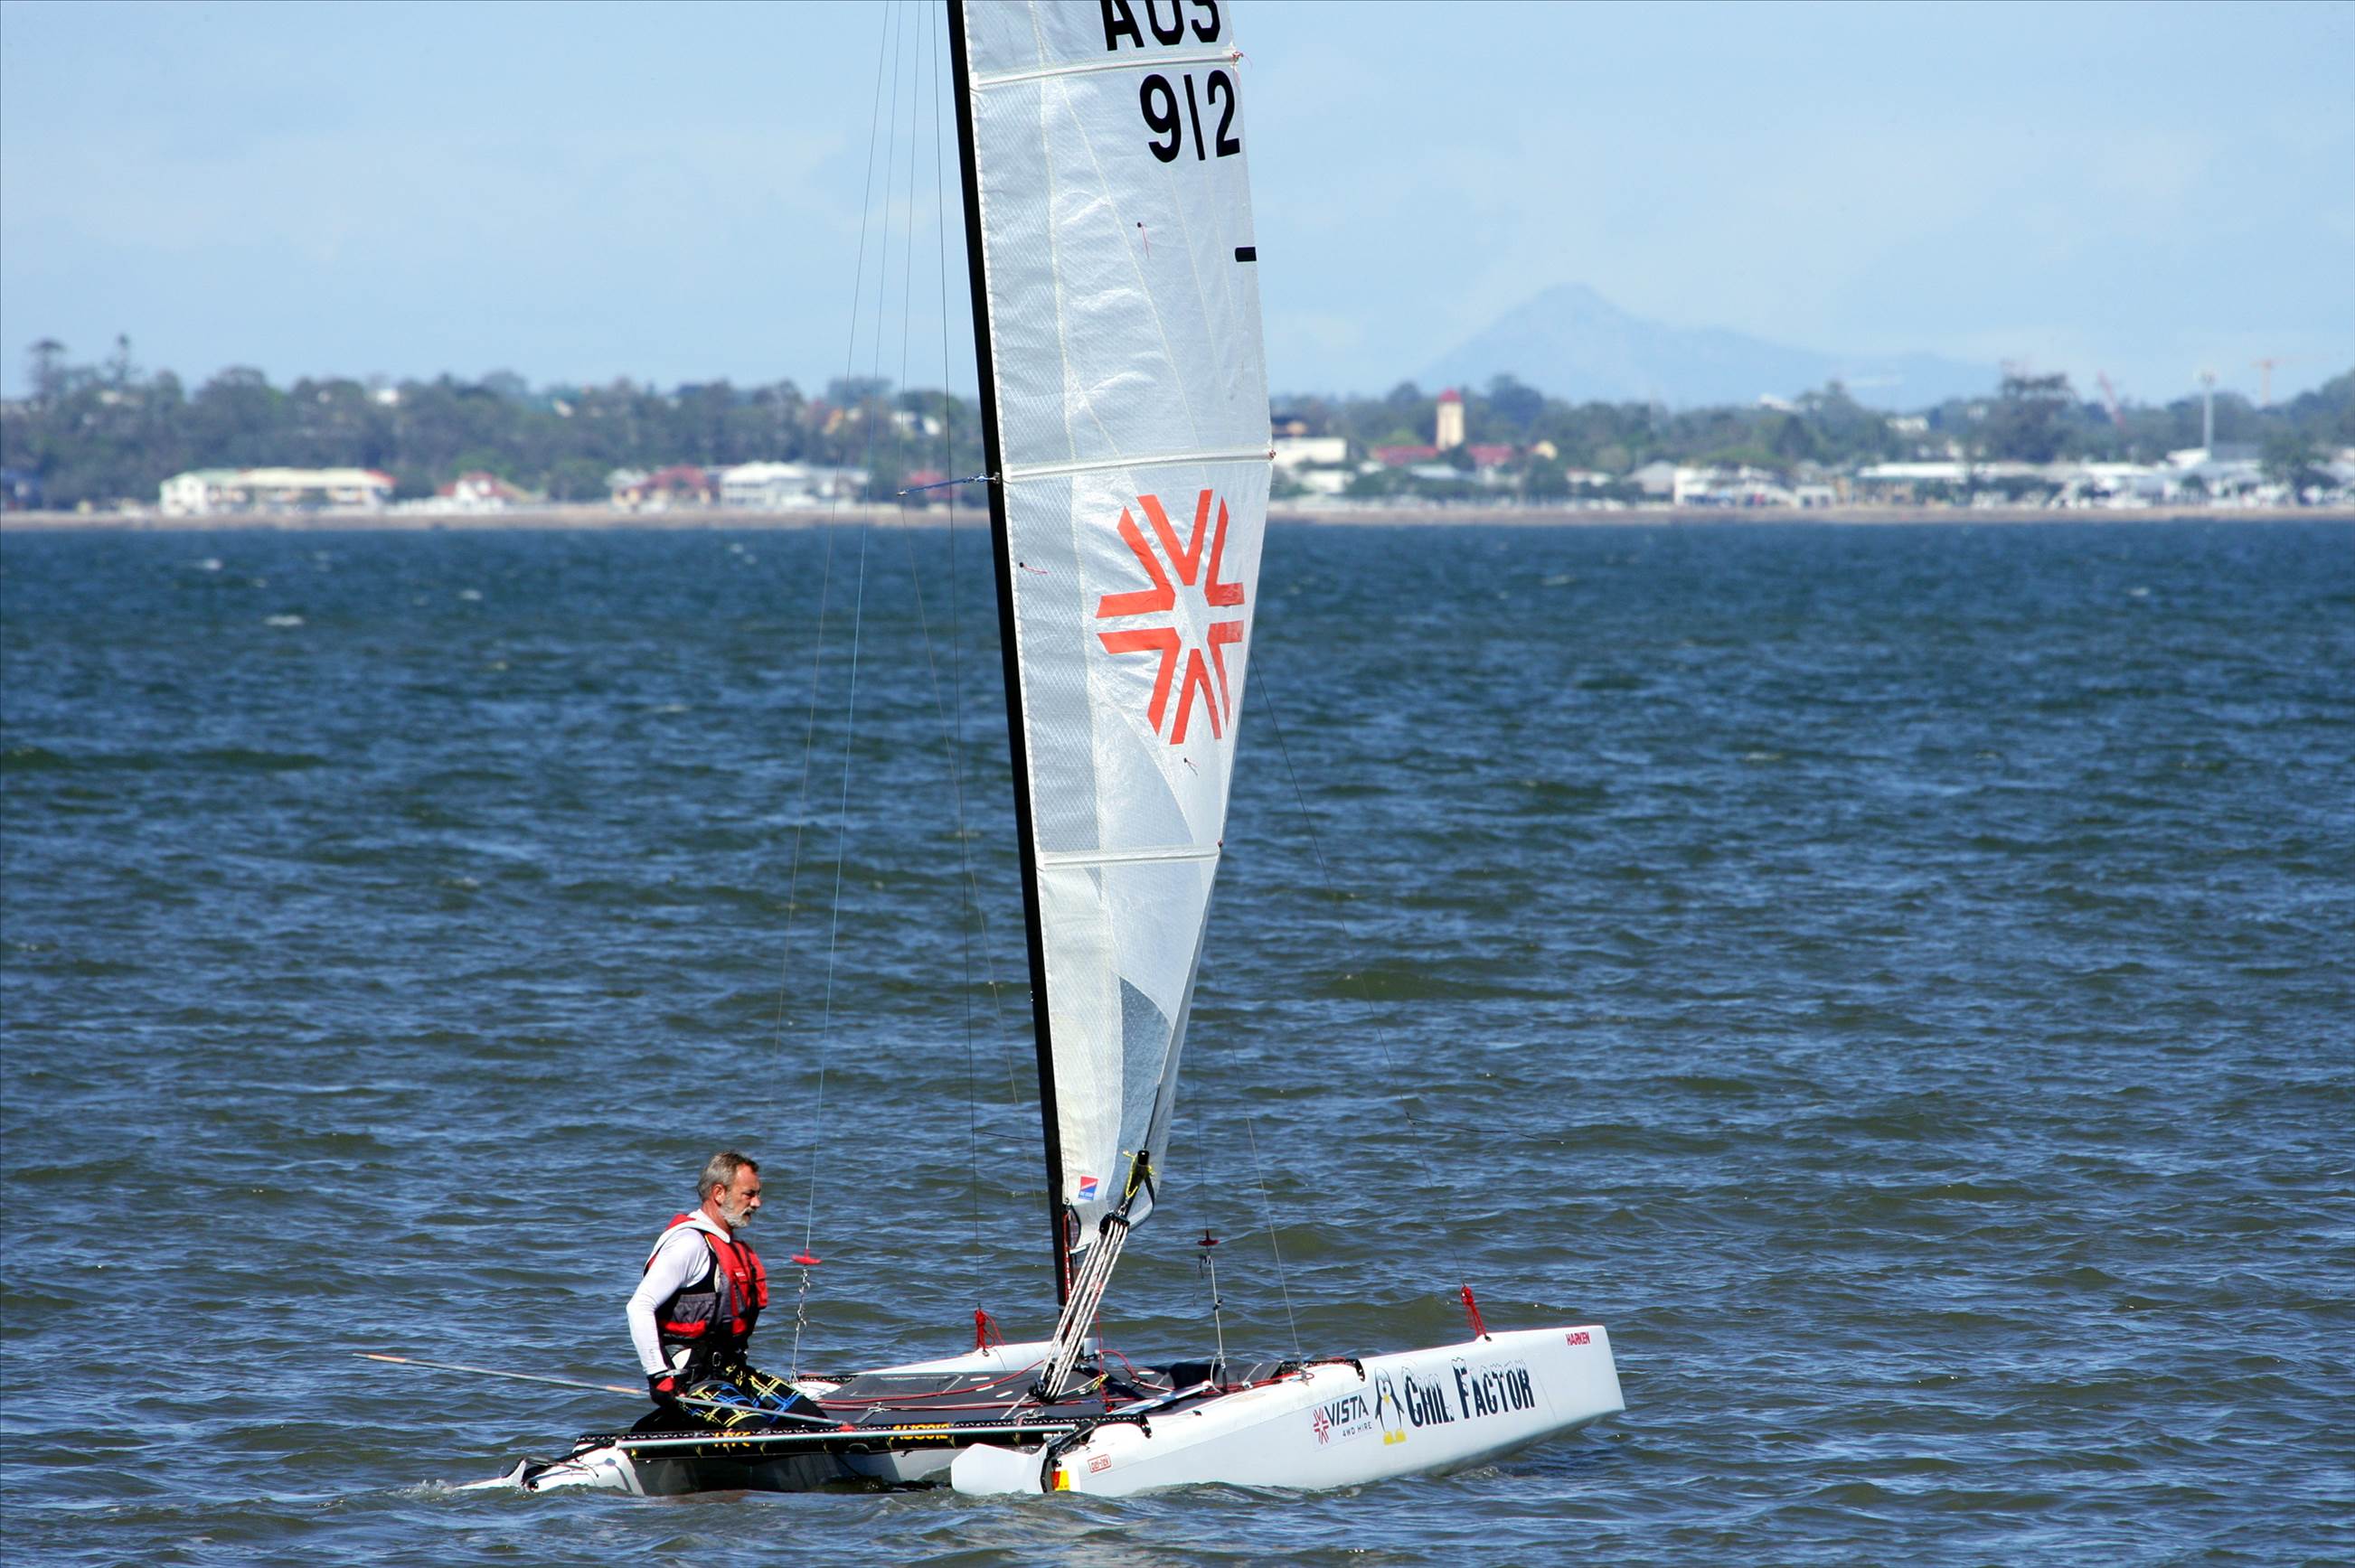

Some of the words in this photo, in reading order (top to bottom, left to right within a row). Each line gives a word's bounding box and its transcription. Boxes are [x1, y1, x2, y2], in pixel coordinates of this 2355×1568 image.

[1100, 0, 1221, 52] AUS
[1139, 70, 1241, 163] 912
[1565, 1331, 1591, 1346] HARKEN
[1324, 1394, 1370, 1426] VISTA
[1342, 1427, 1356, 1437] 4WD
[1358, 1421, 1372, 1432] HIRE
